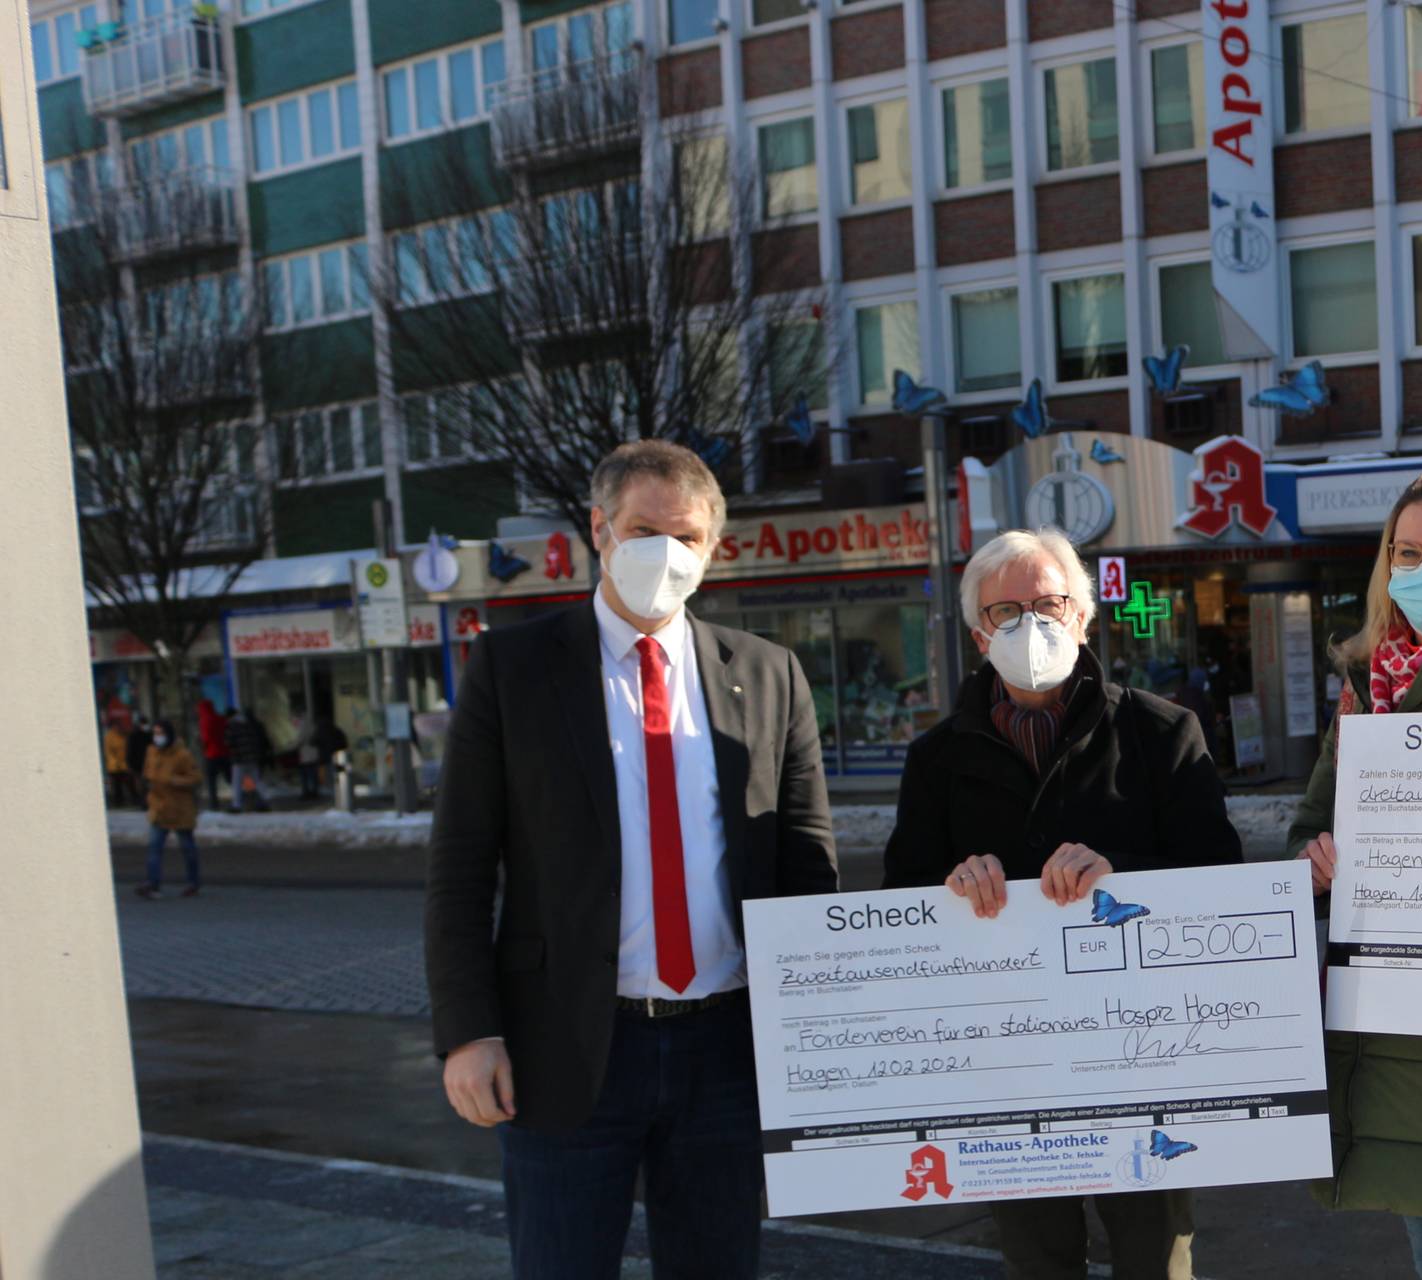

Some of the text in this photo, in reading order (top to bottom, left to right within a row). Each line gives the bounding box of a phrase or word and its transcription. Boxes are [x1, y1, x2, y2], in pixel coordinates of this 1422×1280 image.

[408, 618, 435, 643] ske
[1359, 769, 1387, 778] Zahlen
[1389, 769, 1403, 778] Sie
[1357, 804, 1378, 812] Betrag
[1372, 836, 1394, 844] Betrag
[1354, 859, 1364, 867] an
[1272, 881, 1292, 894] DE
[1353, 883, 1402, 902] Hagen,
[825, 898, 936, 931] Scheck
[775, 943, 940, 963] Zahlen Sie gegen diesen Scheck
[1080, 941, 1106, 952] EUR
[932, 1017, 959, 1044] für
[963, 1023, 990, 1038] ein
[998, 1007, 1098, 1036] stationäres
[1105, 993, 1176, 1030] Hospiz
[1185, 988, 1261, 1032] Hagen
[958, 1131, 1108, 1157] Rathaus-Apotheke
[959, 1155, 1017, 1166] Internationale
[1020, 1152, 1059, 1163] Apotheke
